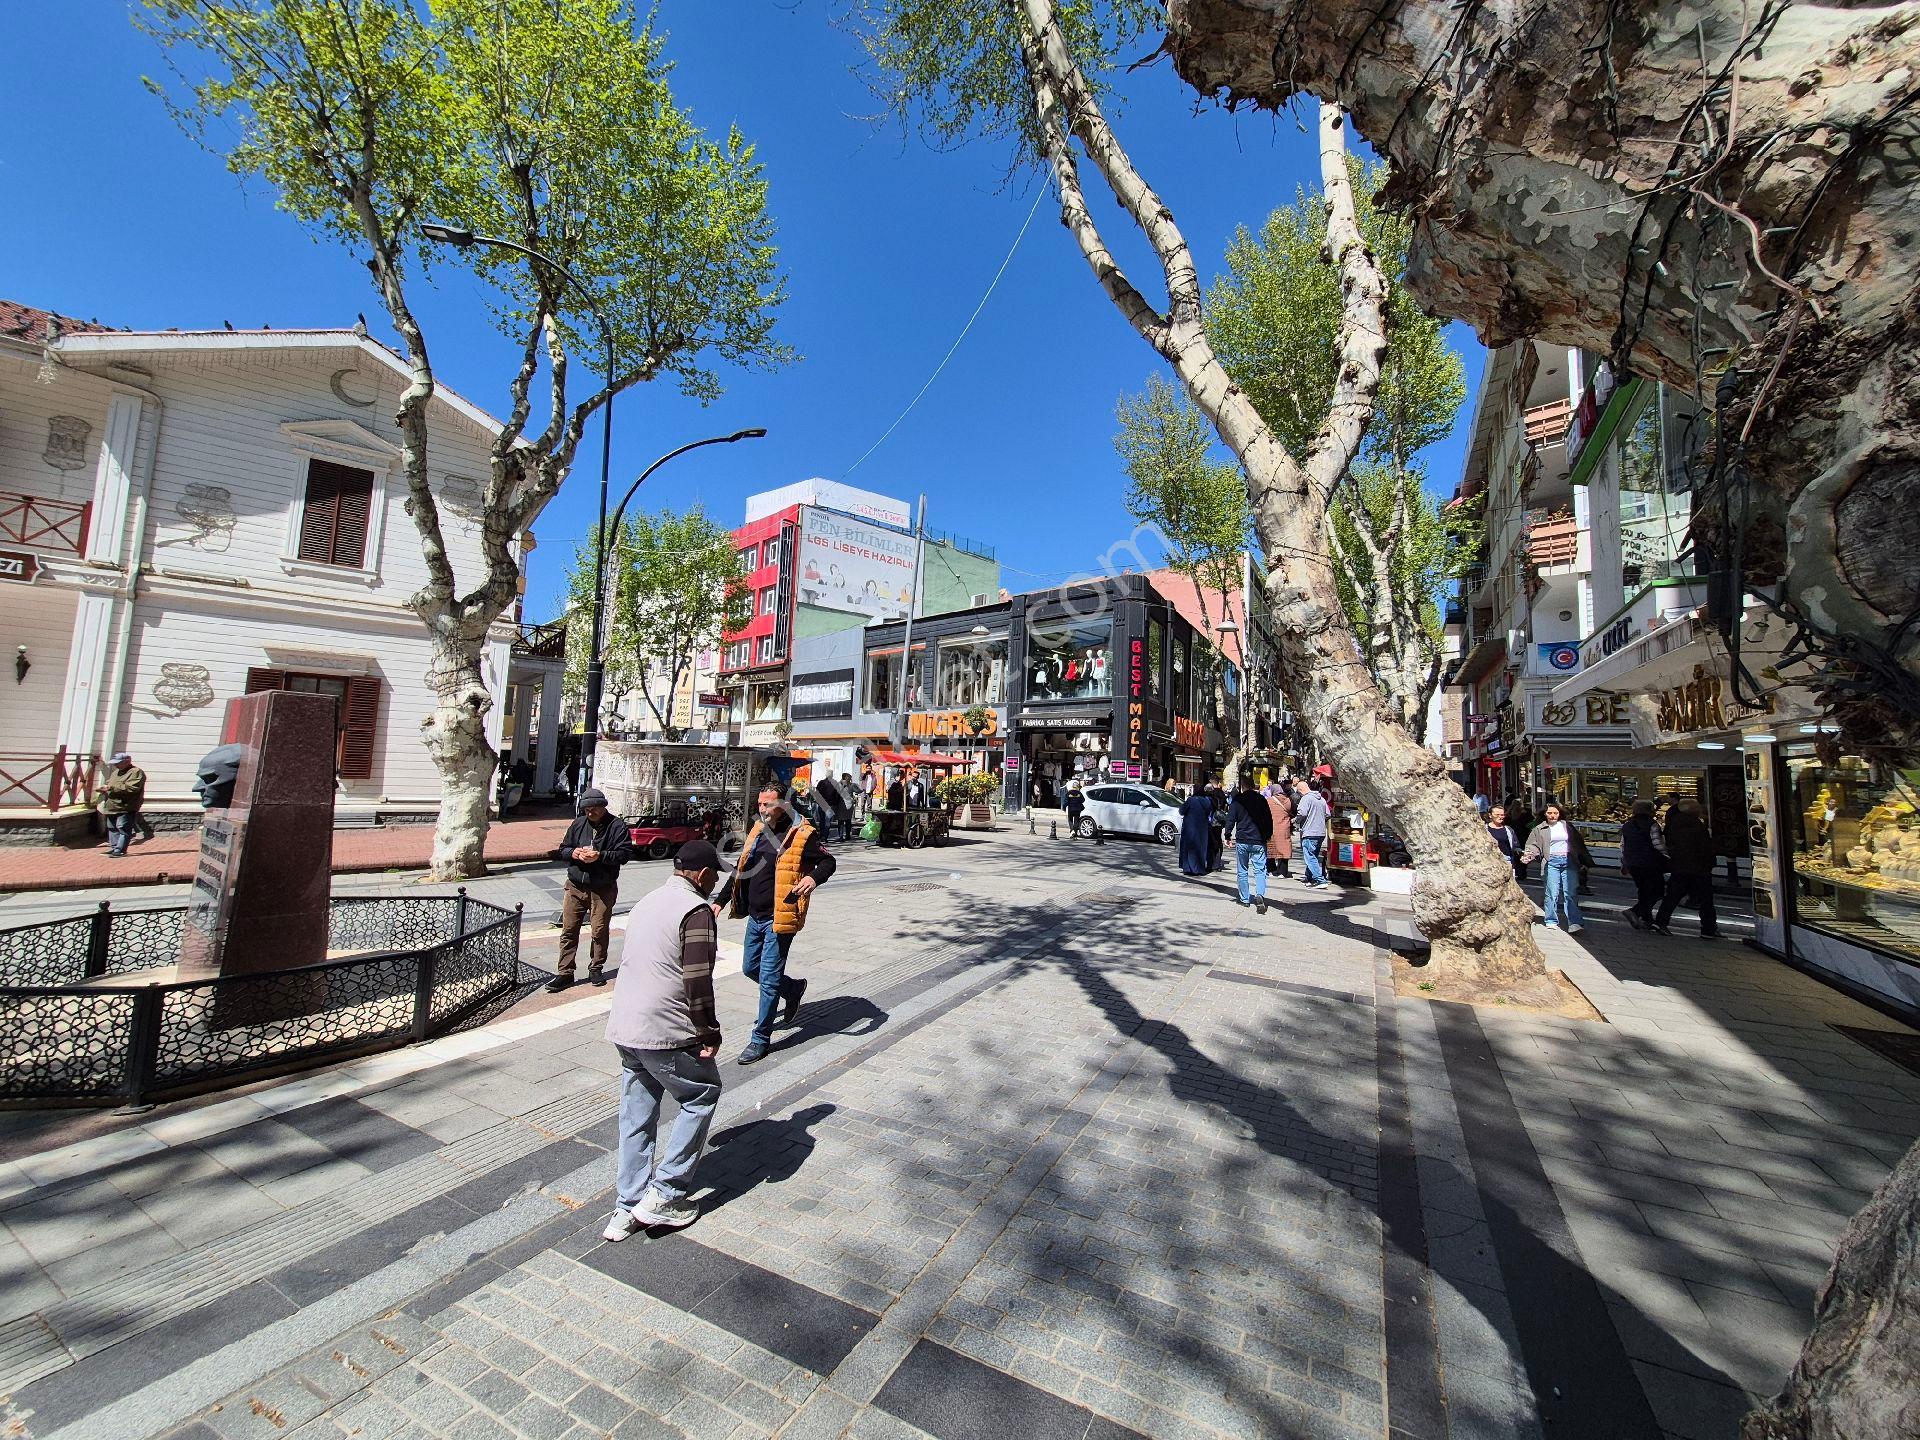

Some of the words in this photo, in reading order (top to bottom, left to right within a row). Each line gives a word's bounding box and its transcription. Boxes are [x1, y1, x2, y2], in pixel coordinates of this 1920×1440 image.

[807, 533, 829, 548] LGS
[833, 539, 870, 558] LİSEYE
[809, 518, 840, 537] FEN
[845, 527, 916, 557] BİLİMLER
[1131, 640, 1143, 697] BEST
[908, 708, 998, 738] MİGRS
[1022, 718, 1045, 726] FABRİKA
[1047, 719, 1062, 727] SATIŞ
[1063, 718, 1092, 726] MAĞAZASI
[1129, 702, 1143, 760] MALL
